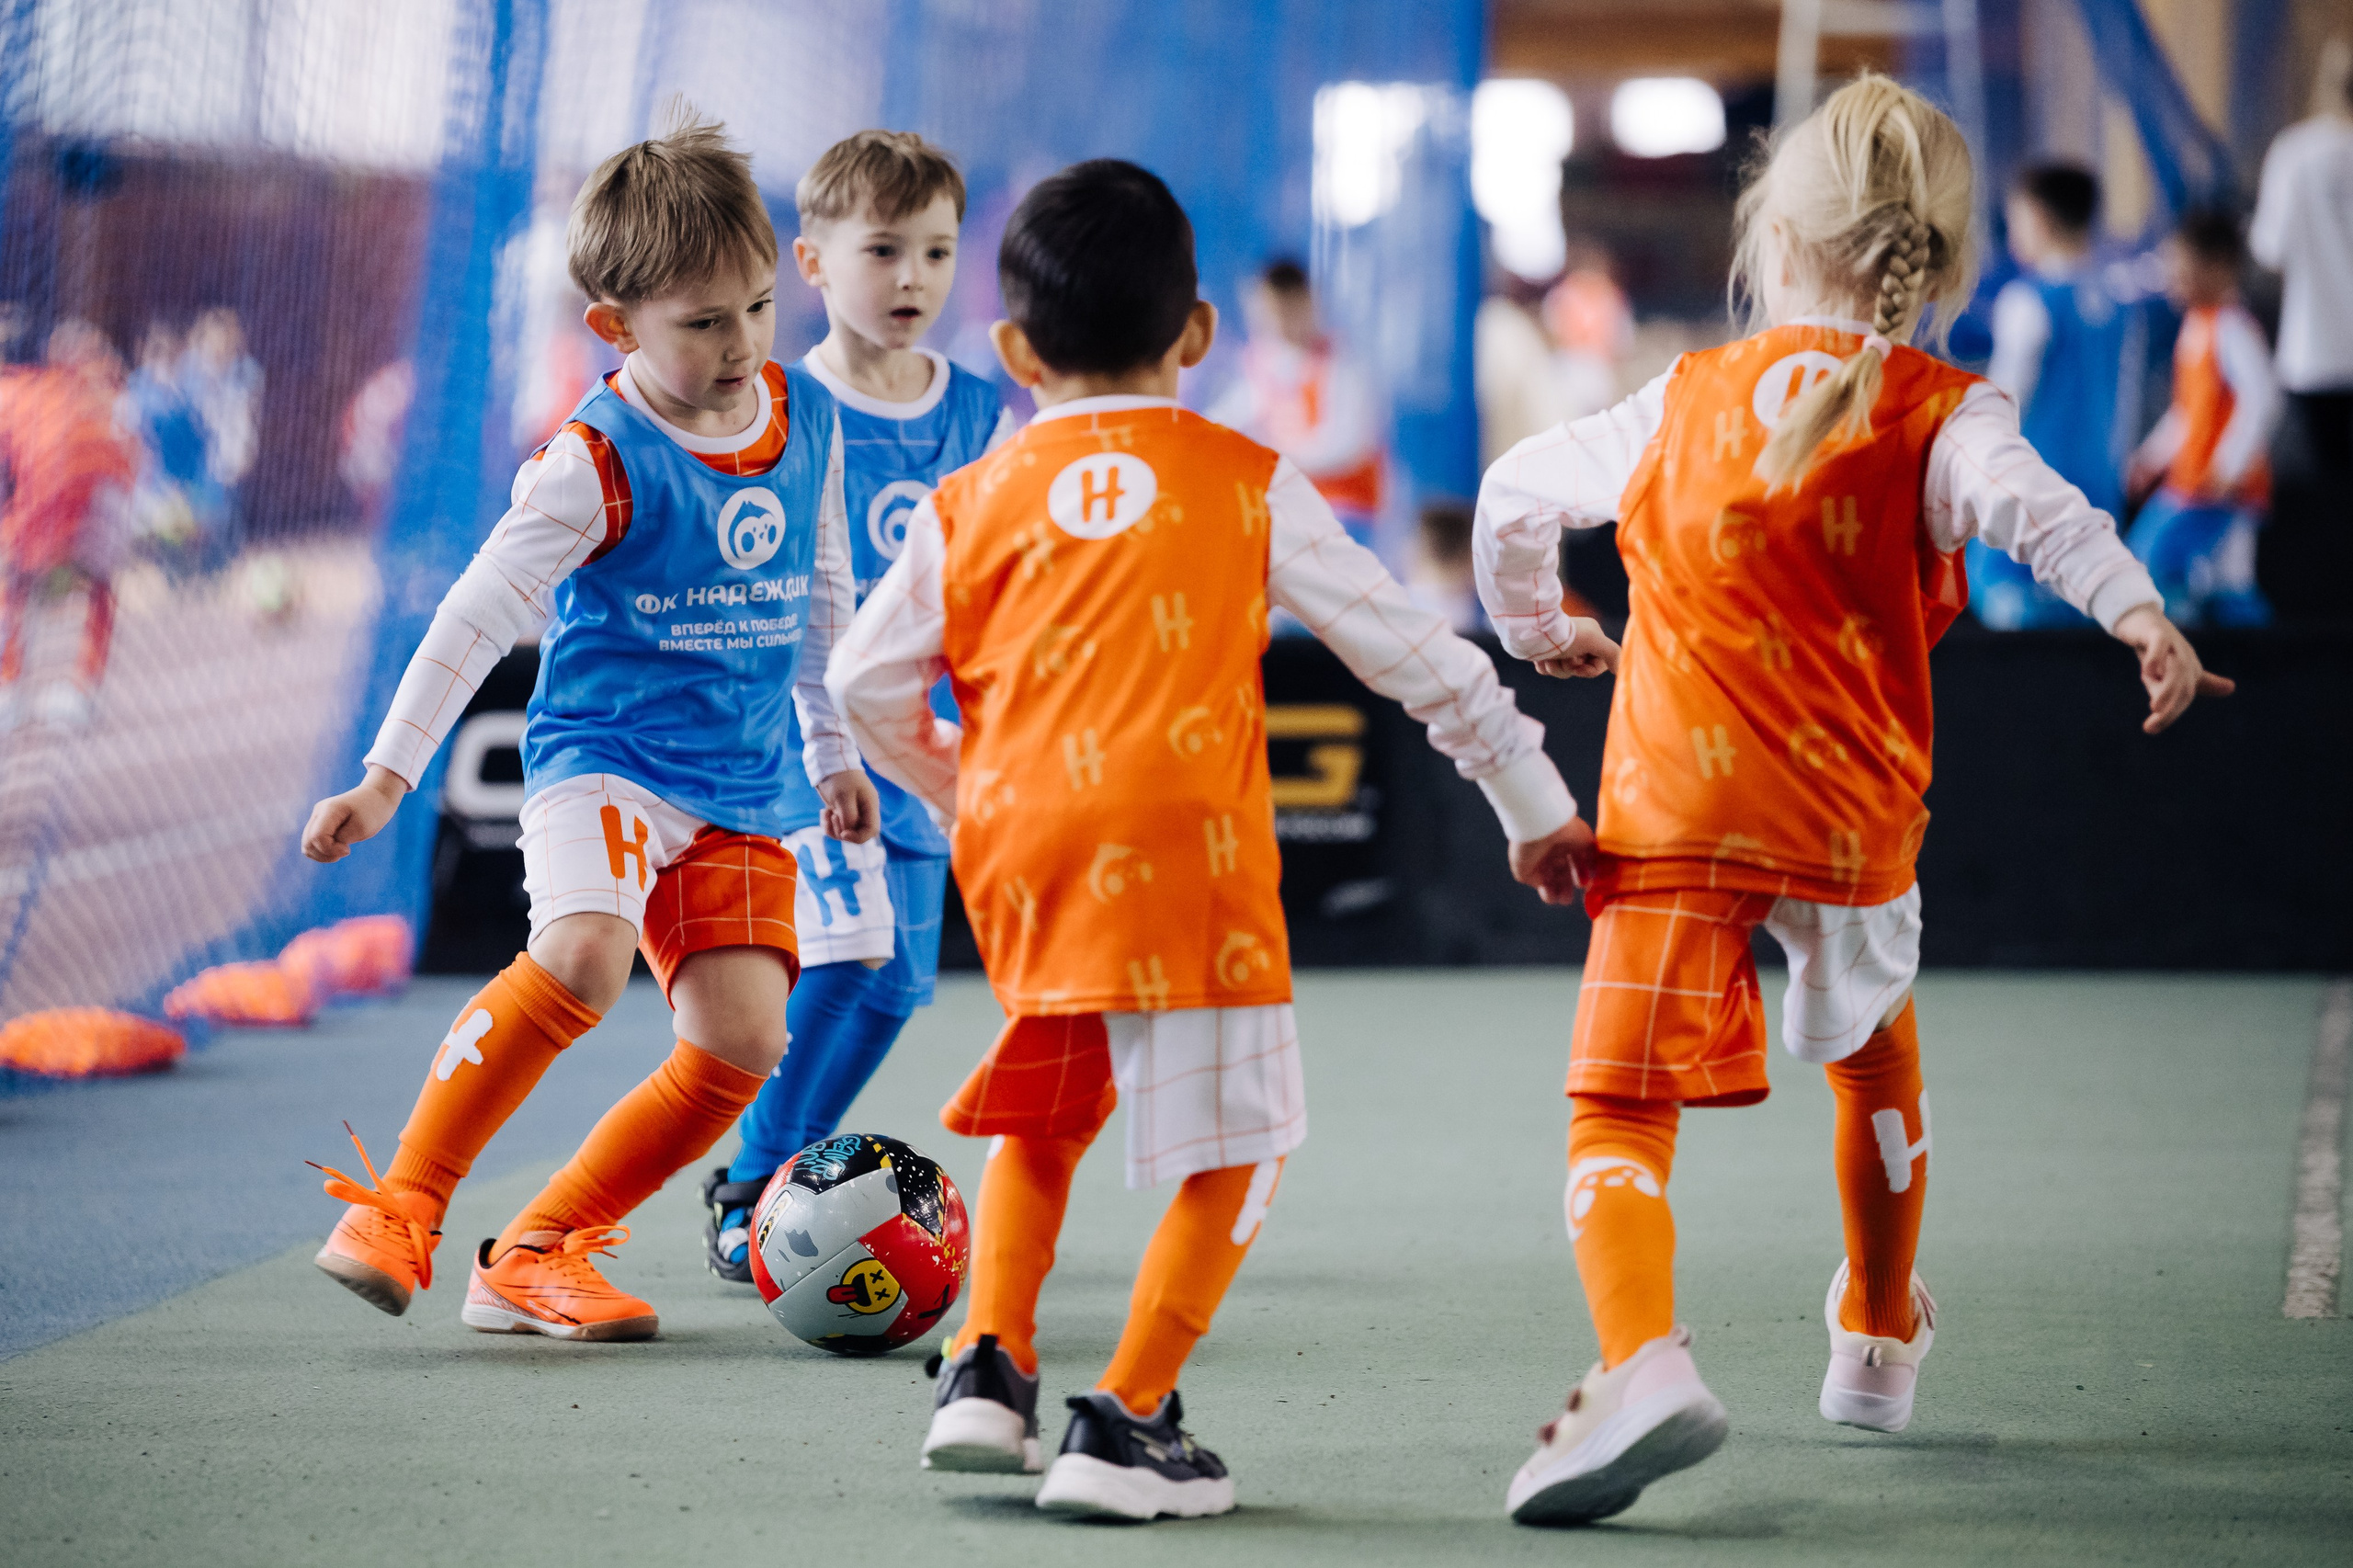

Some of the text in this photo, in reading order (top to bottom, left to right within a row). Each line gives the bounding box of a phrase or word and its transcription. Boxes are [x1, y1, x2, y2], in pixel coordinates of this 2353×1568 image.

[635, 593, 679, 614] ФК
[671, 619, 736, 637] ВПЕРЁД
[739, 620, 749, 634] К
[659, 638, 722, 652] ВМЕСТЕ
[726, 637, 754, 649] МЫ
